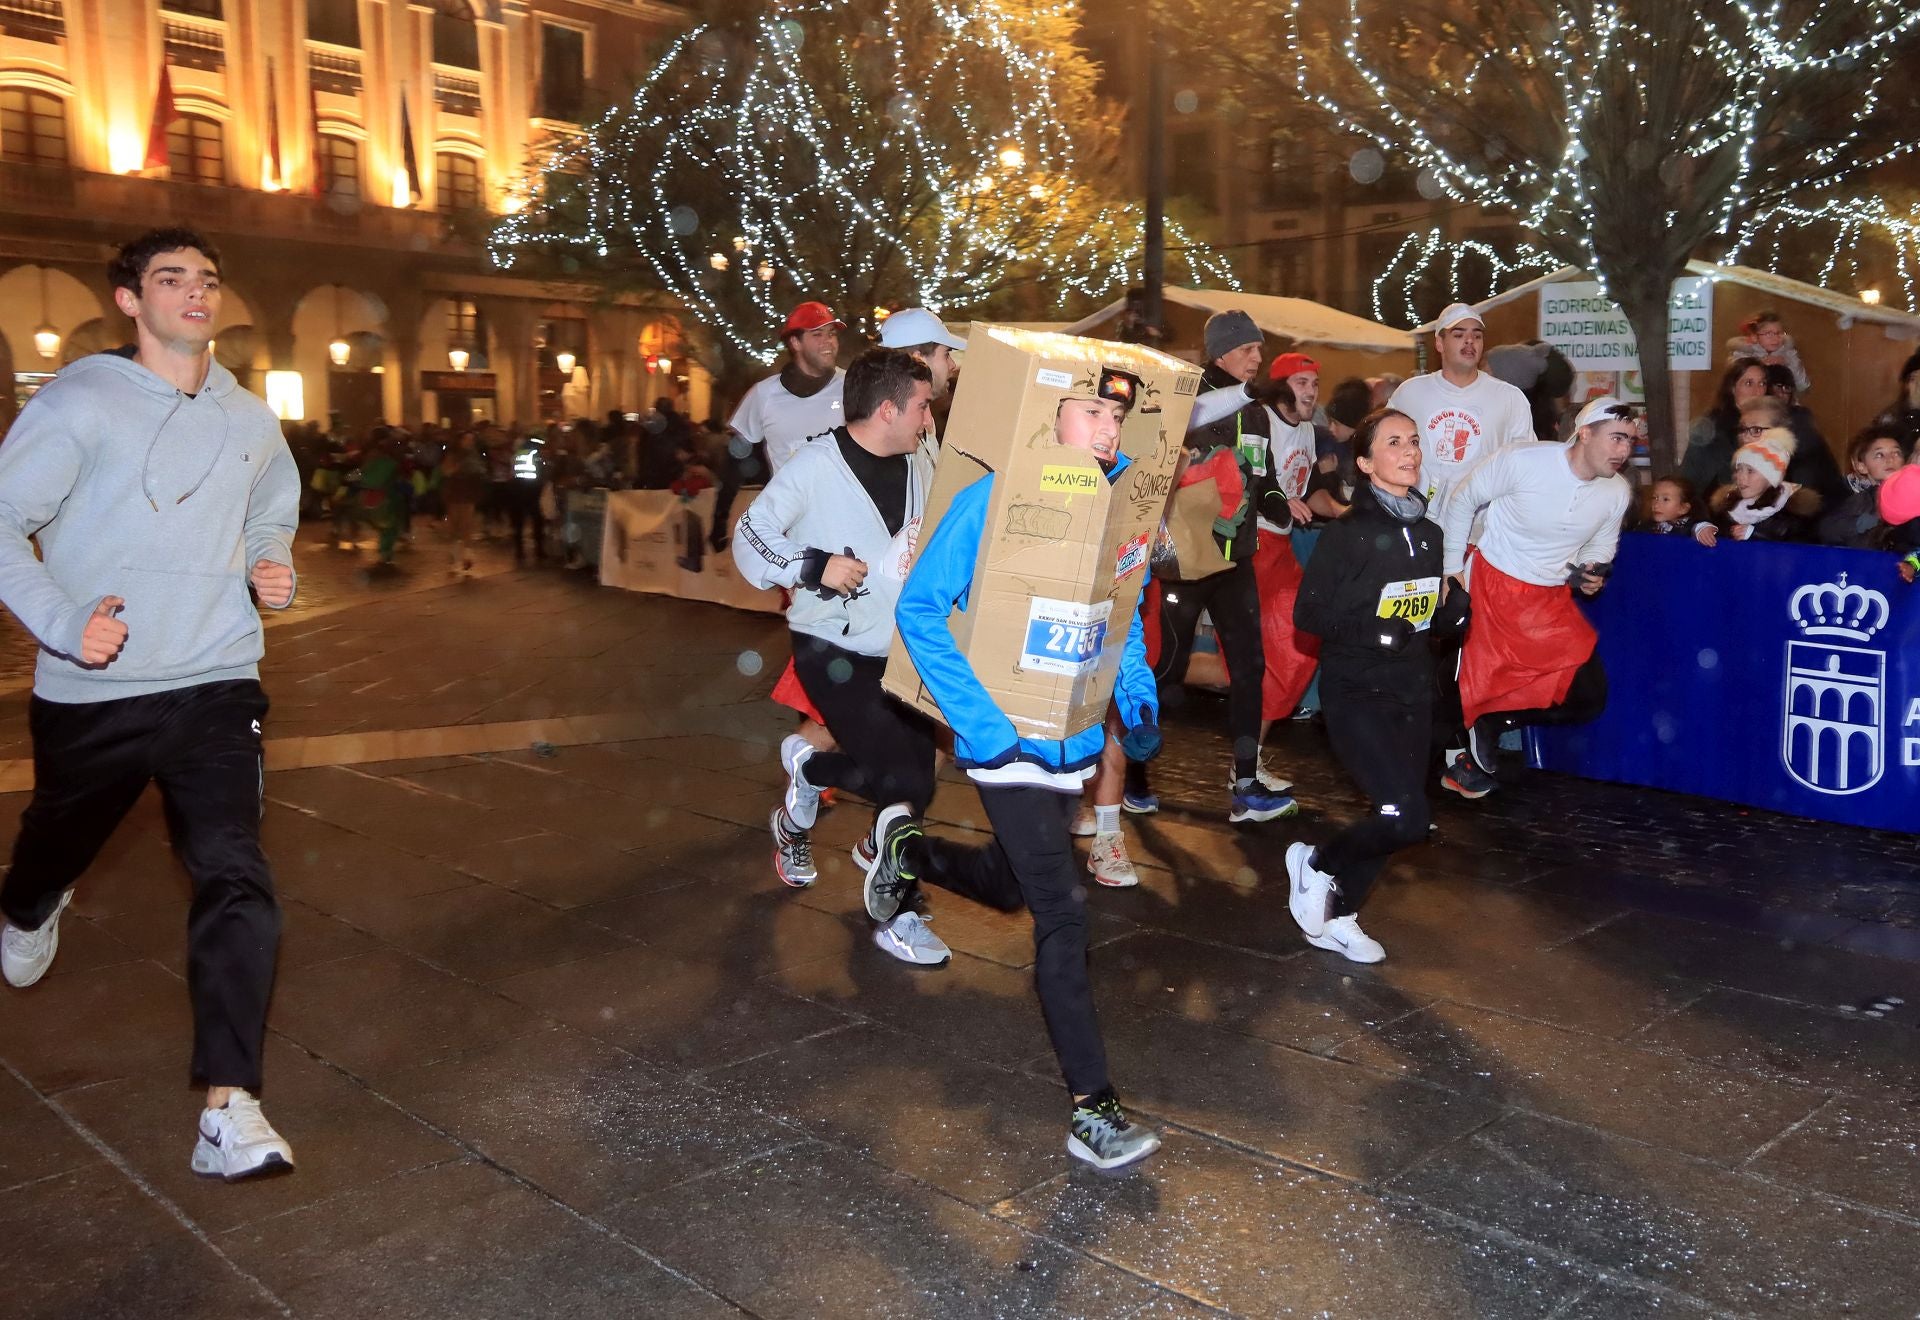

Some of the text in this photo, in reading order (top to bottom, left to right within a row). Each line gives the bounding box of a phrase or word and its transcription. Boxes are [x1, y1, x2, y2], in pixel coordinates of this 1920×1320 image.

[1545, 298, 1612, 314] GORROS
[1545, 319, 1628, 336] DIADEMAS
[1555, 340, 1620, 358] RTÍCULOS
[1055, 473, 1098, 488] HEAVY
[1391, 595, 1429, 618] 2269
[1045, 623, 1099, 655] 2755
